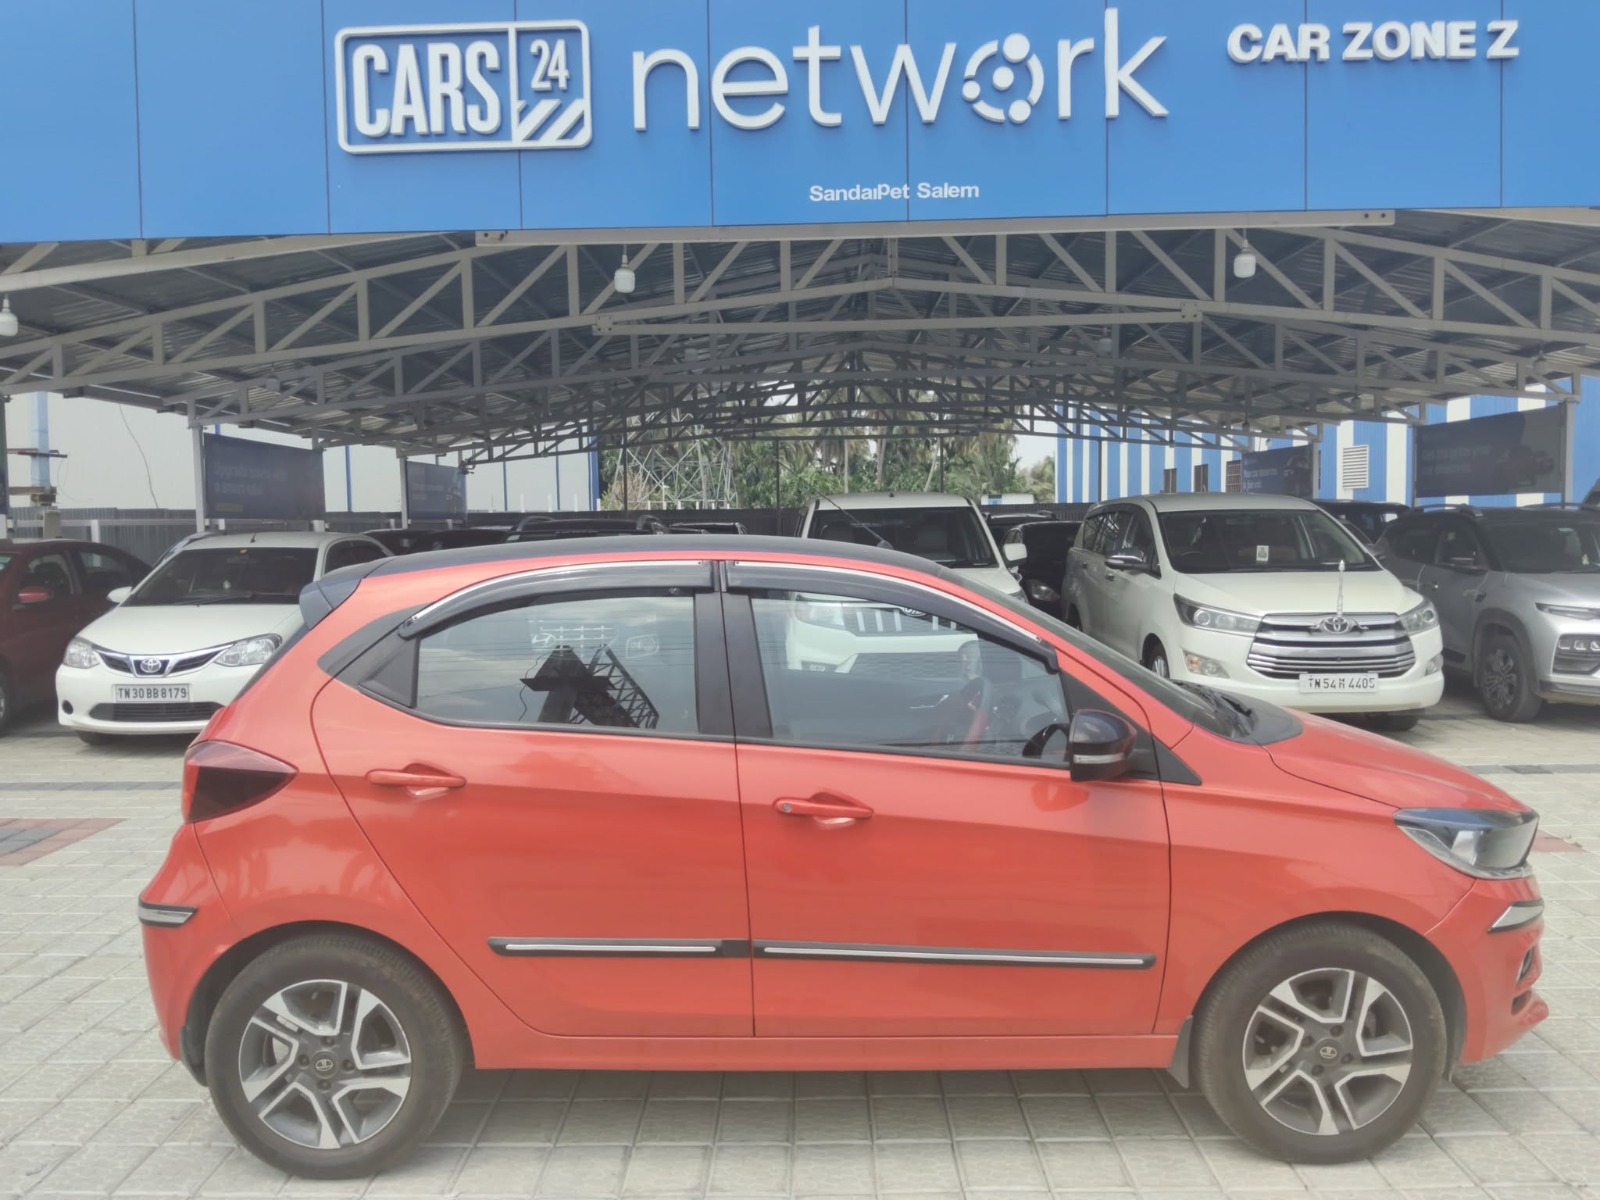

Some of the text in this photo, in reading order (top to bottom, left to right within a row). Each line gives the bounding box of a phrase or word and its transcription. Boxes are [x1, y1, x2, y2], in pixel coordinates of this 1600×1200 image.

[1227, 19, 1520, 63] CAR ZONE Z
[352, 7, 1168, 138] CARS 24 network
[917, 182, 980, 199] Salem
